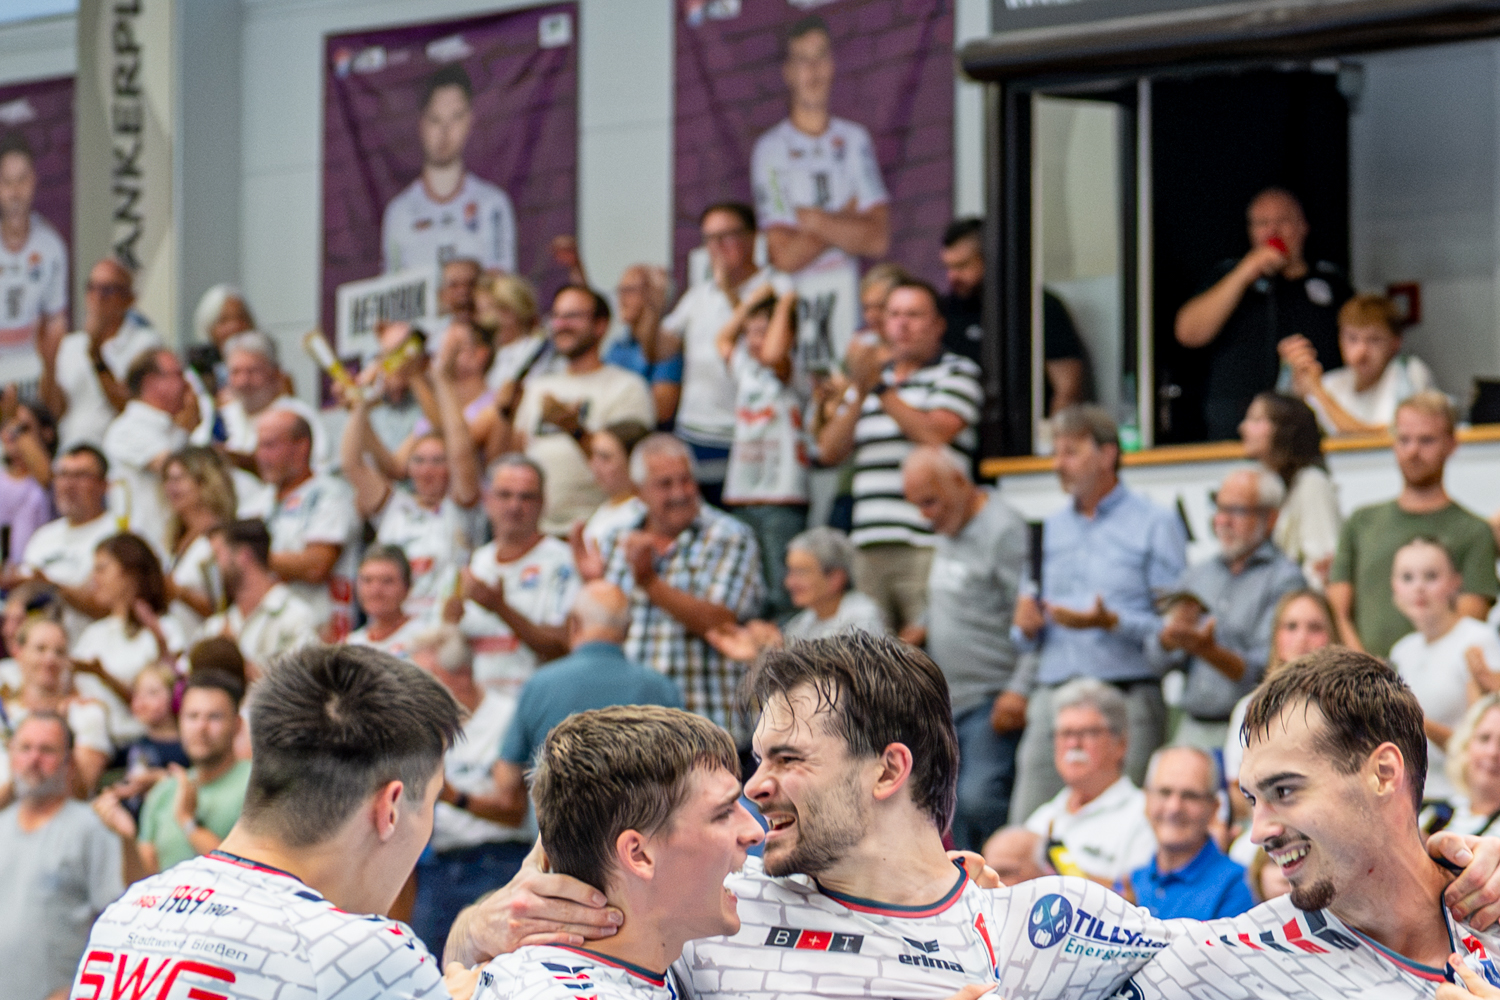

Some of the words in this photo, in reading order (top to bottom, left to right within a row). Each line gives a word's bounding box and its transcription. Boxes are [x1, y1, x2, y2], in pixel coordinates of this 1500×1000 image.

[158, 885, 215, 915] 1969
[191, 938, 249, 962] Gießen
[898, 952, 965, 973] erima
